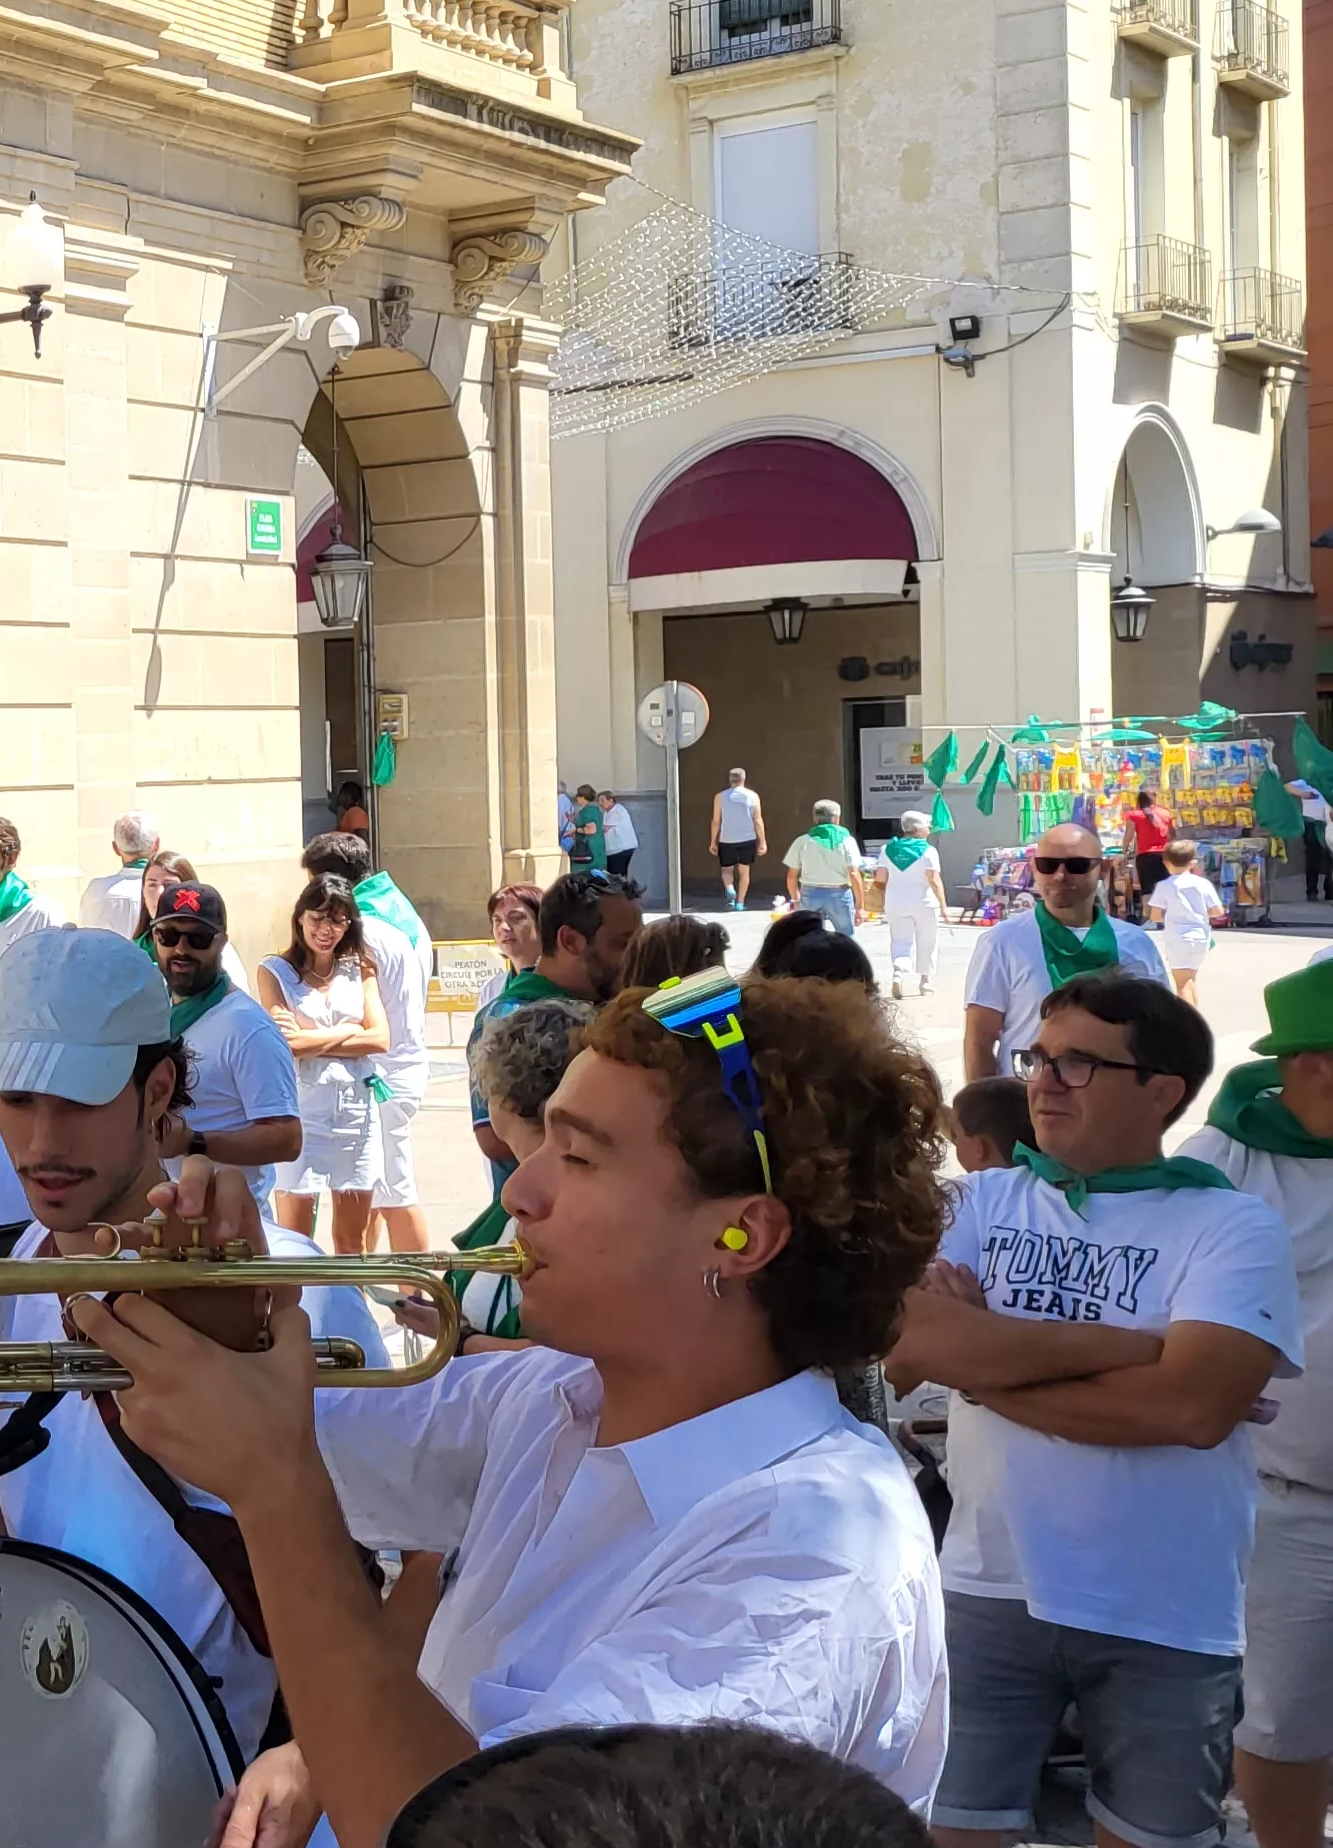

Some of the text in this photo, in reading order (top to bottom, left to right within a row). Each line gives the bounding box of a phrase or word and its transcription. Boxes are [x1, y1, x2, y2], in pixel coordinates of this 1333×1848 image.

[454, 959, 487, 969] PEATÓN
[475, 970, 492, 978] POR
[445, 980, 468, 989] OTRA
[981, 1225, 1159, 1315] TOMMY
